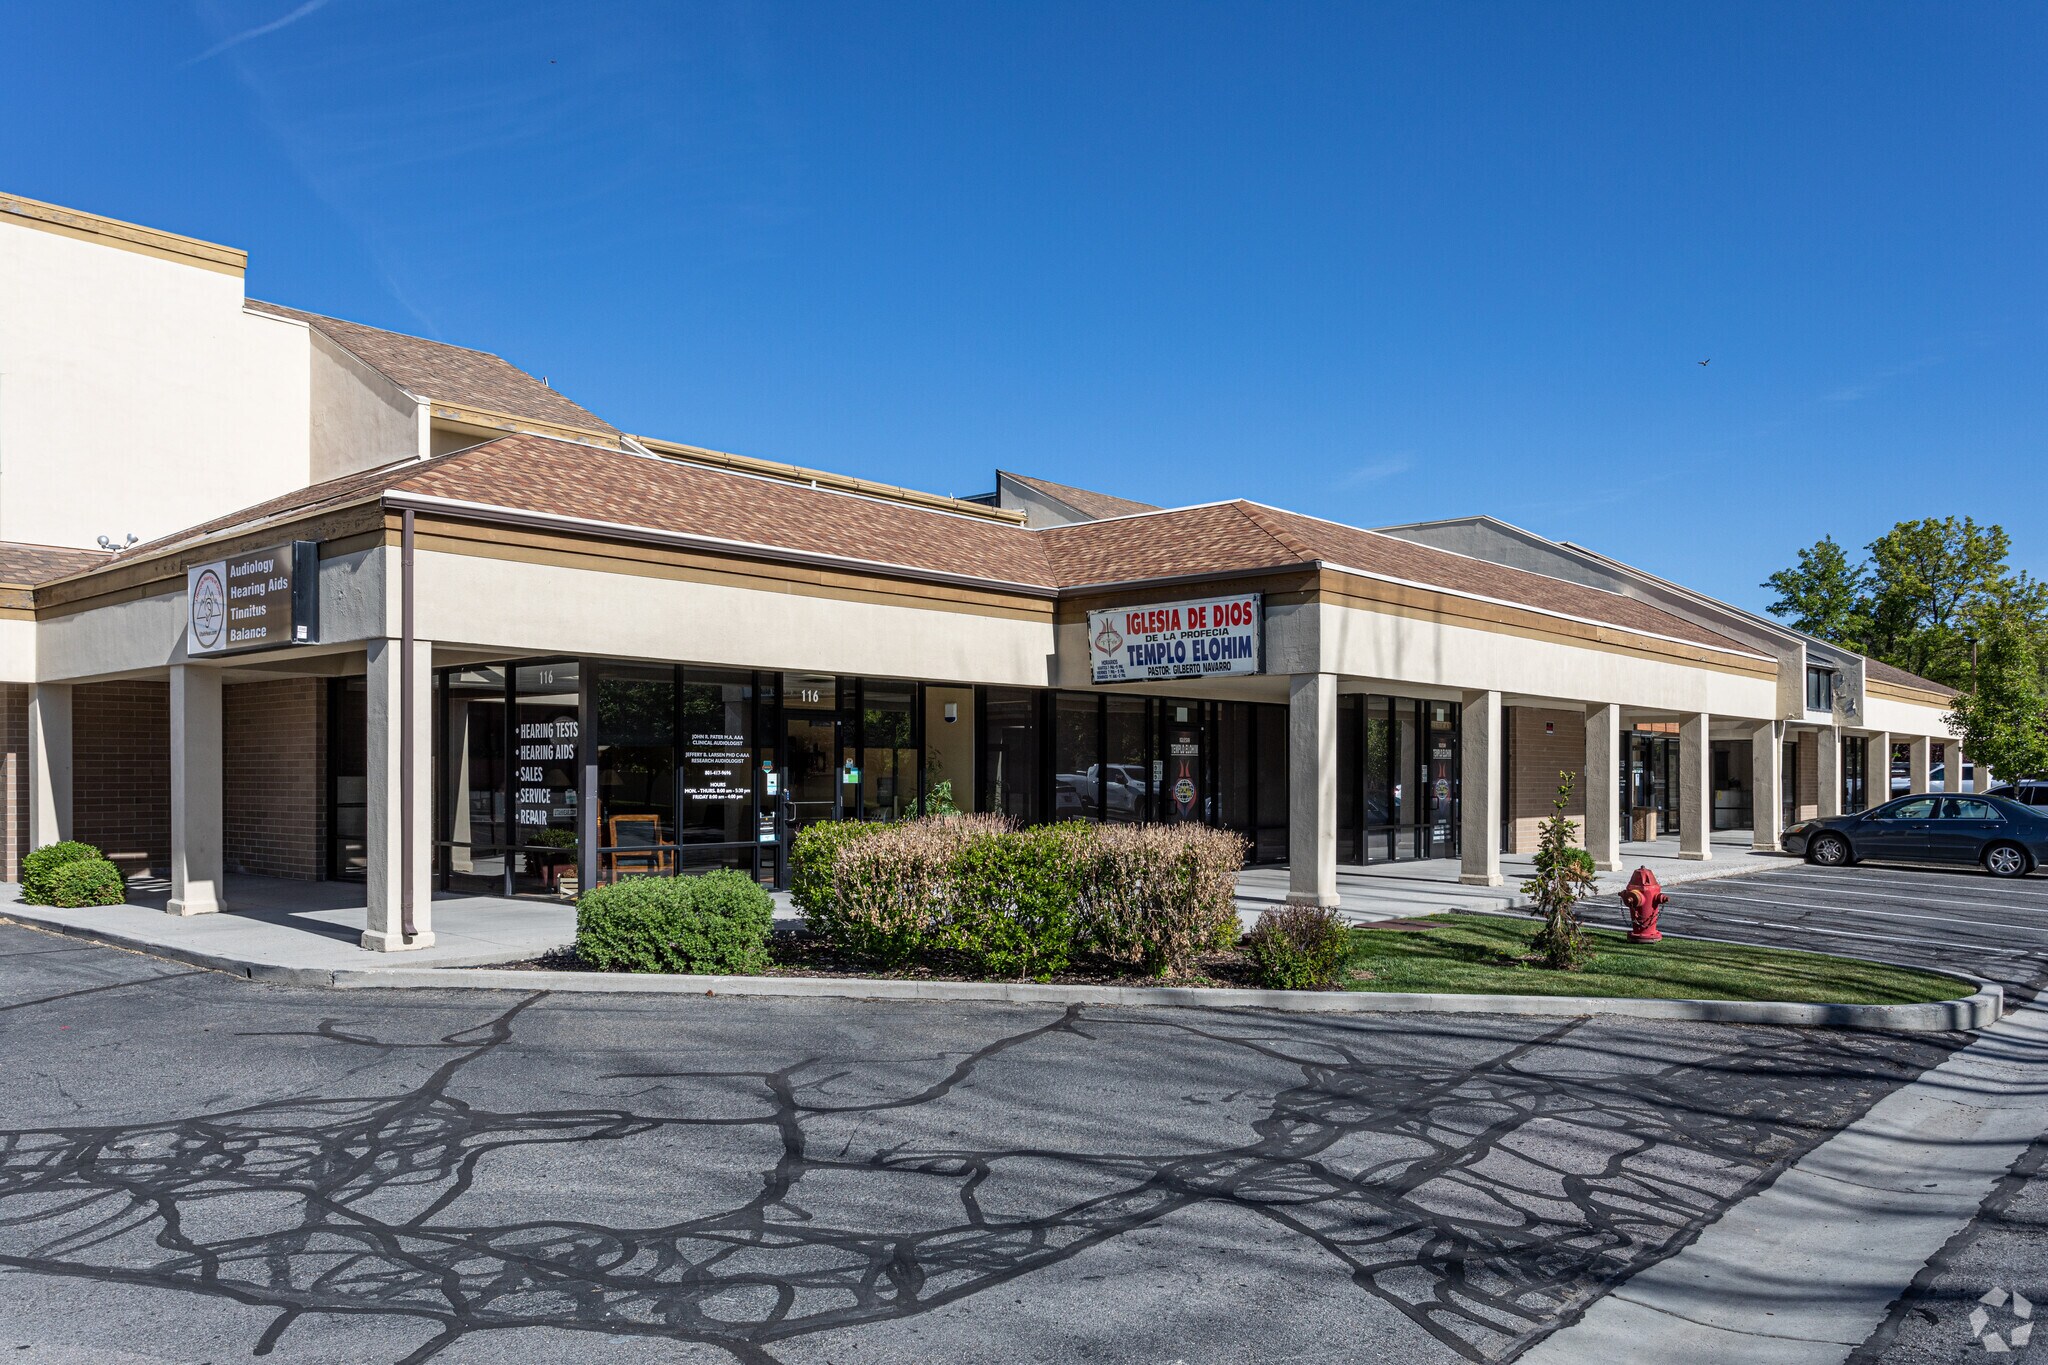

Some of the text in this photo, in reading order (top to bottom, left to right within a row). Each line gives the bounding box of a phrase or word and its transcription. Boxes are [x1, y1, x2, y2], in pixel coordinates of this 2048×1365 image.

[230, 559, 274, 578] Audiology
[230, 584, 266, 599] Hearing
[268, 577, 288, 592] Aids
[230, 604, 266, 620] Tinnitus
[1126, 601, 1253, 635] IGLESIA DE DIOS
[230, 626, 267, 642] Balance
[1146, 634, 1158, 642] DE
[1181, 628, 1229, 639] PROFECIA
[1127, 636, 1252, 666] TEMPLO ELOHIM
[1148, 661, 1232, 676] PASTOR: GILBERTO NAVARRO
[539, 670, 553, 684] 116
[801, 690, 819, 702] 116
[520, 722, 578, 738] HEARING TESTS
[520, 744, 574, 760] HEARING AIDS
[520, 767, 543, 782] SALES
[520, 788, 550, 803] SERVICE
[520, 809, 547, 825] REPAIR
